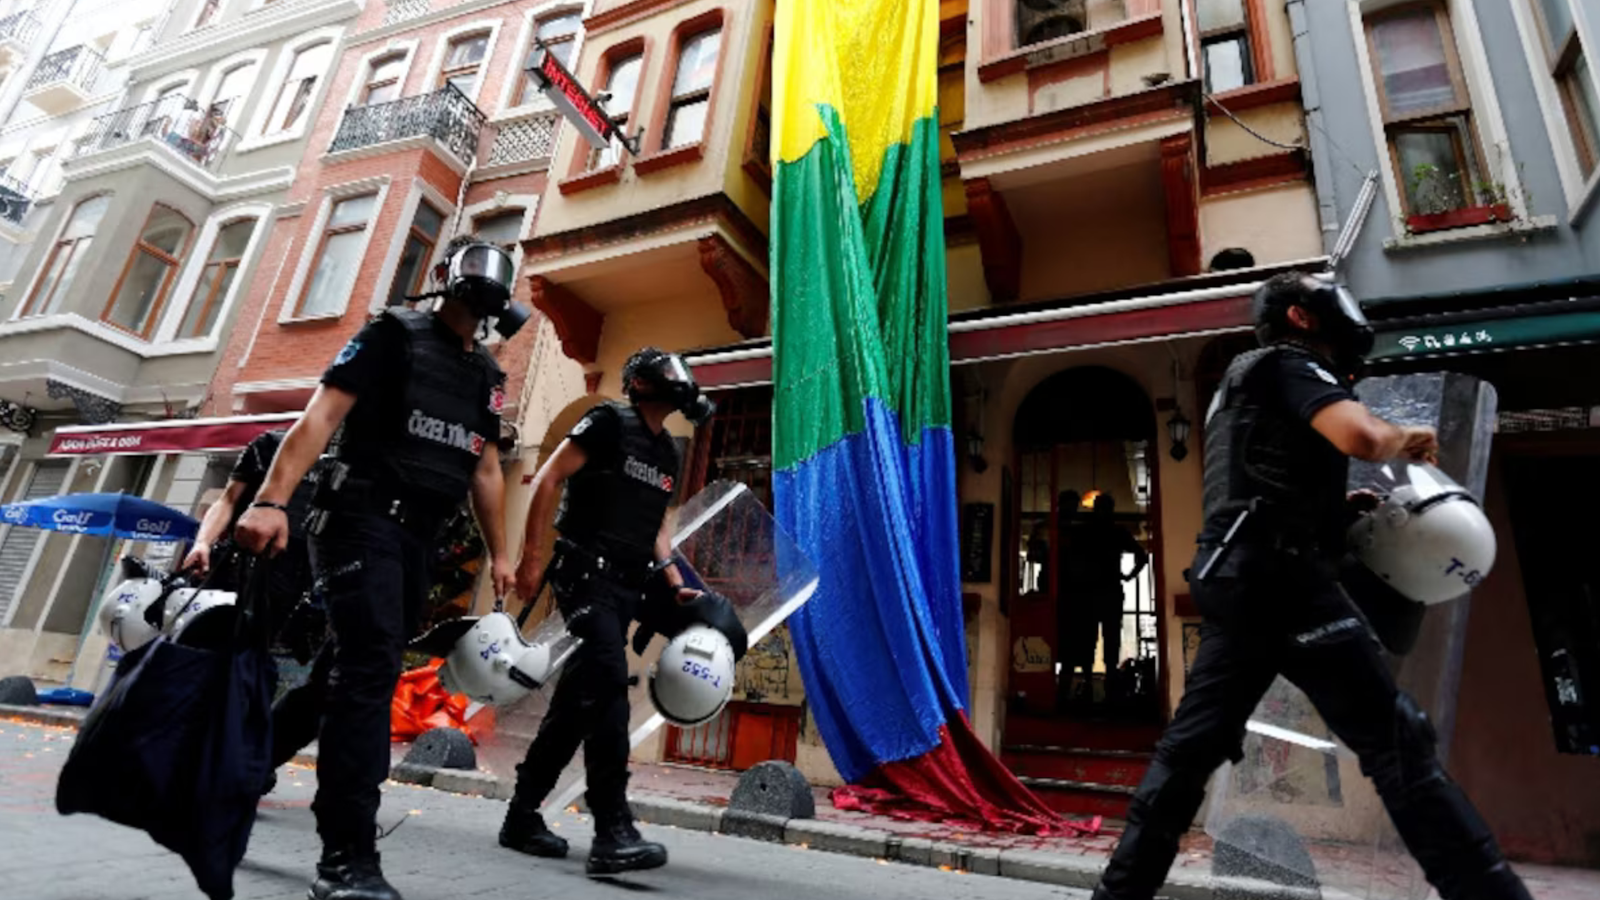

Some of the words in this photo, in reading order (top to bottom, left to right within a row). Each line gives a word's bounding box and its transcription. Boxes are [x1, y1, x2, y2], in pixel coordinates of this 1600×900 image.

[408, 409, 446, 443] ÖZEL
[53, 509, 93, 525] Golf
[136, 518, 171, 534] Golf
[1445, 557, 1485, 588] T-6
[682, 660, 721, 689] T-552
